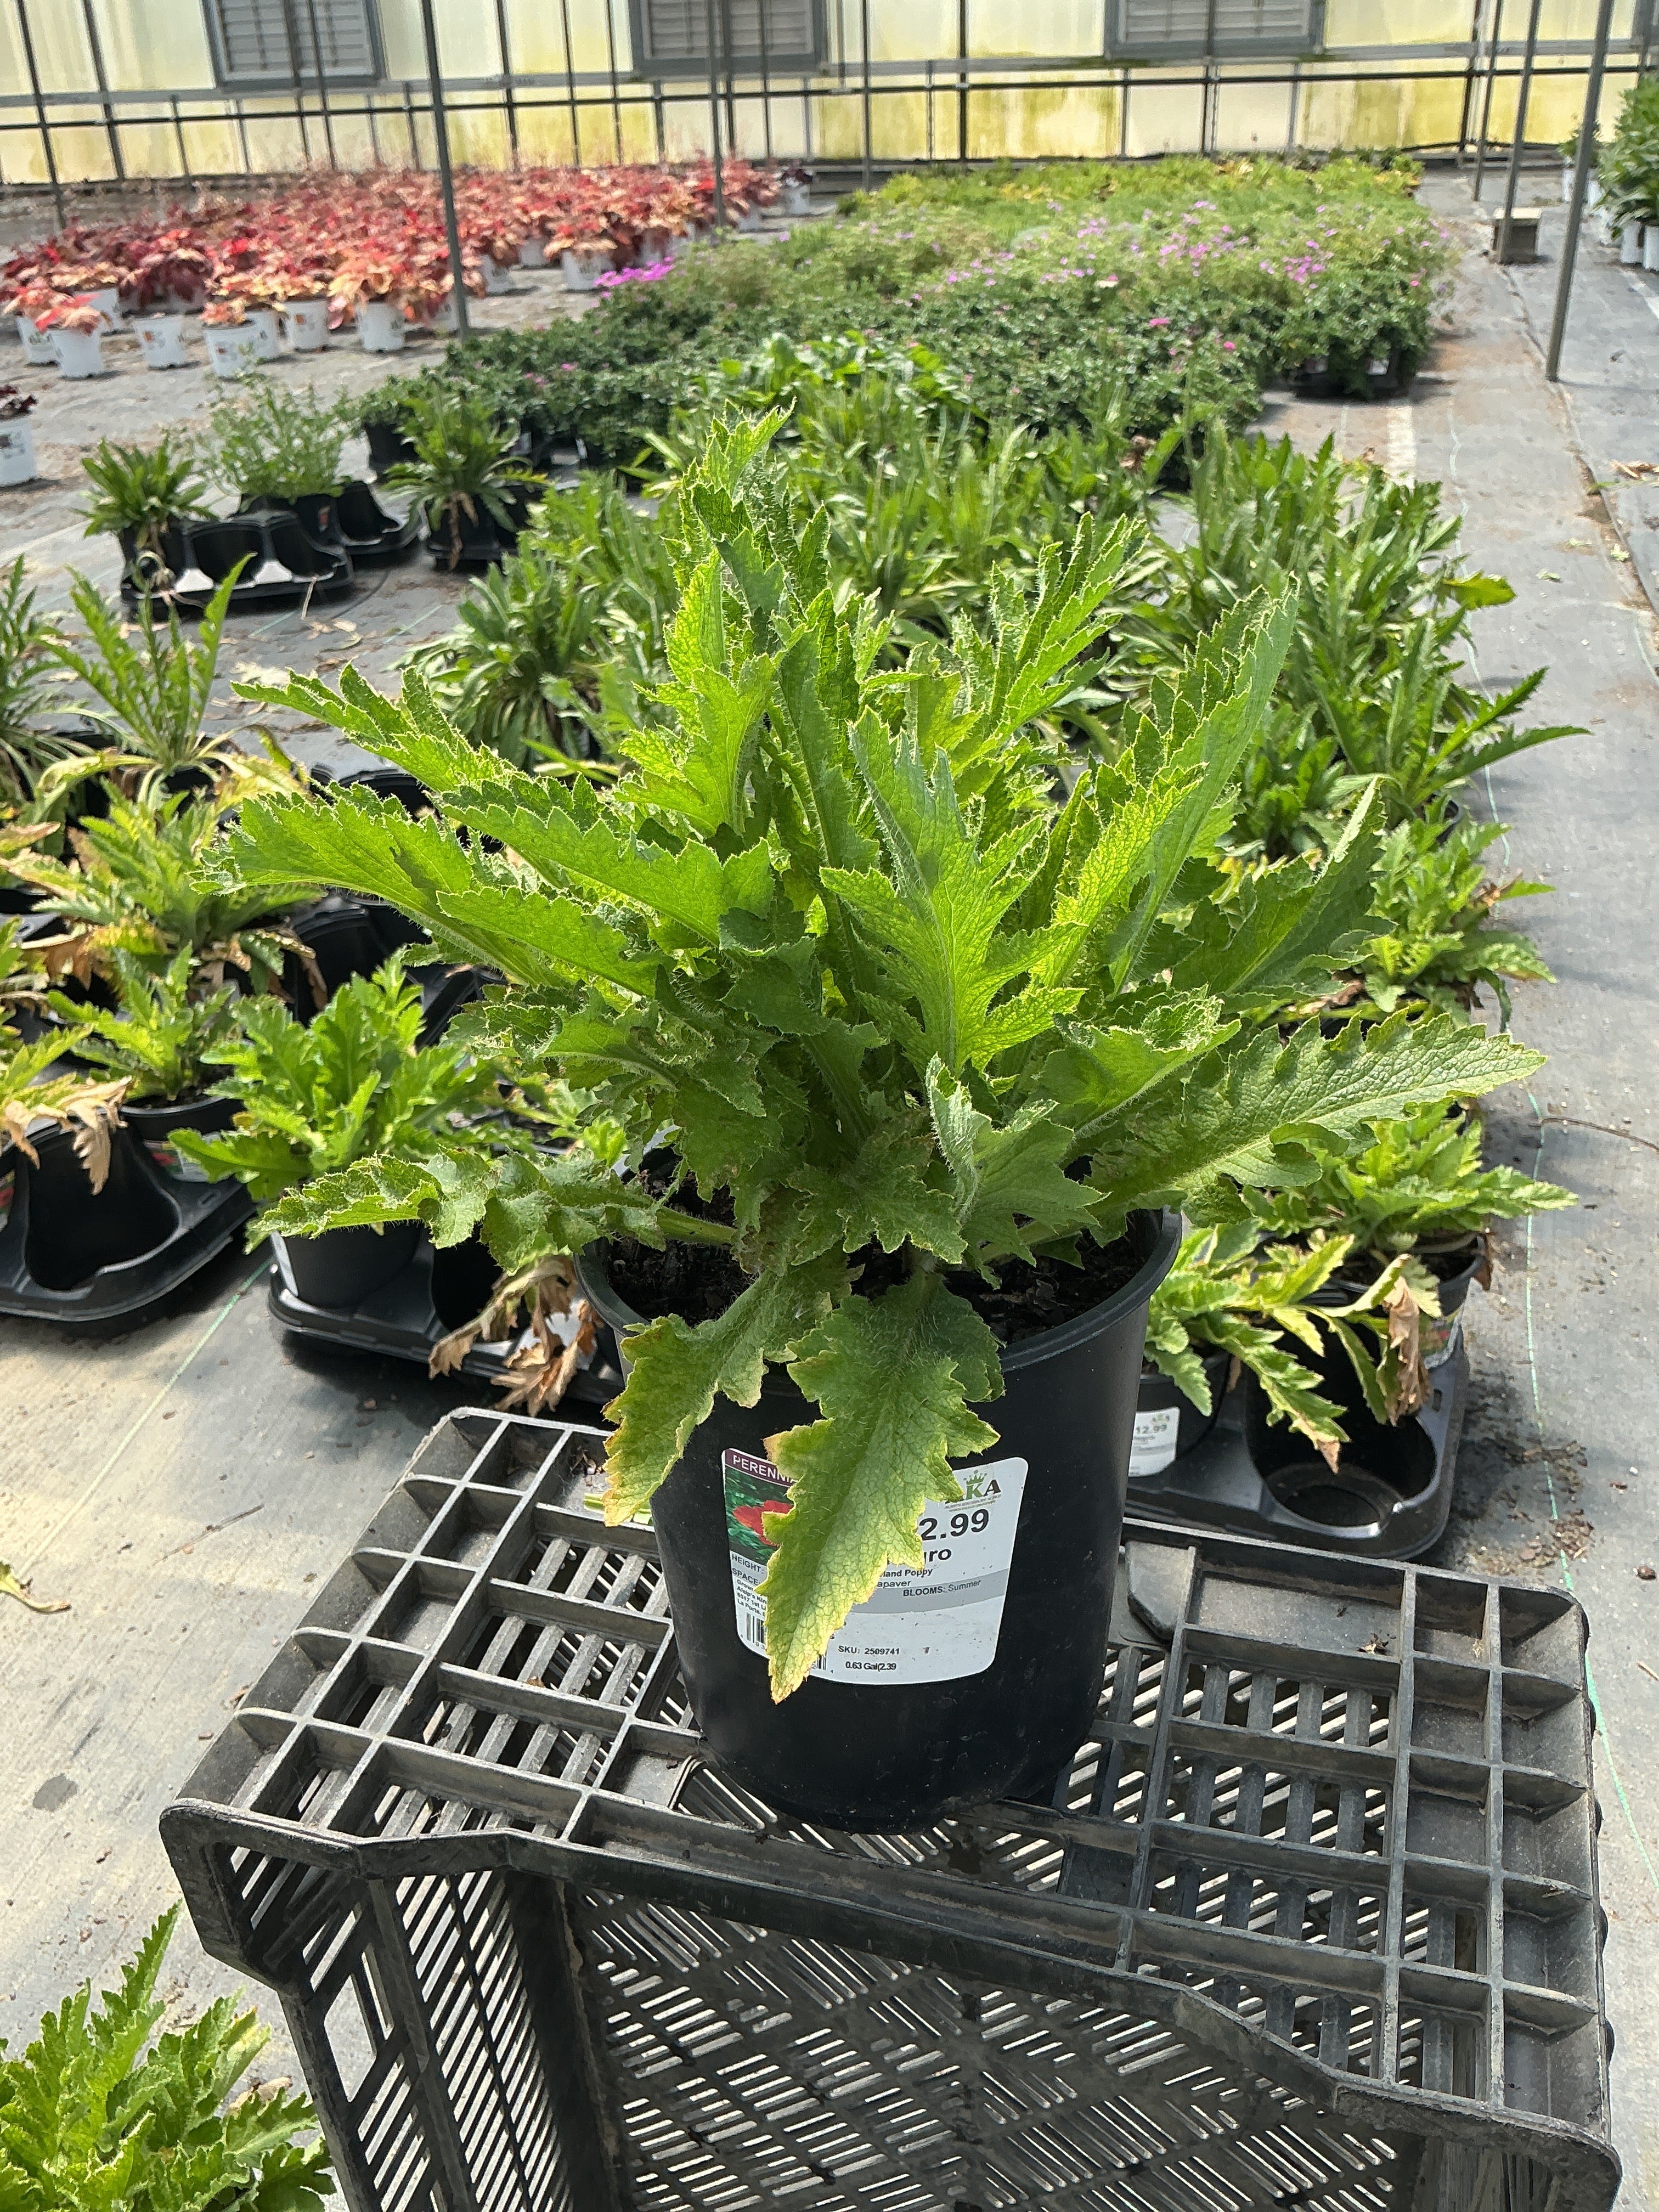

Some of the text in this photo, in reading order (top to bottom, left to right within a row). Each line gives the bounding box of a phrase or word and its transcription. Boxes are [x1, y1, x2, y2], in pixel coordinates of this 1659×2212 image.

[923, 1549, 952, 1563] ro
[905, 1568, 933, 1578] Poppy
[947, 1579, 981, 1592] Summer
[838, 1645, 860, 1654] SKU:
[845, 1661, 862, 1669] 0.63
